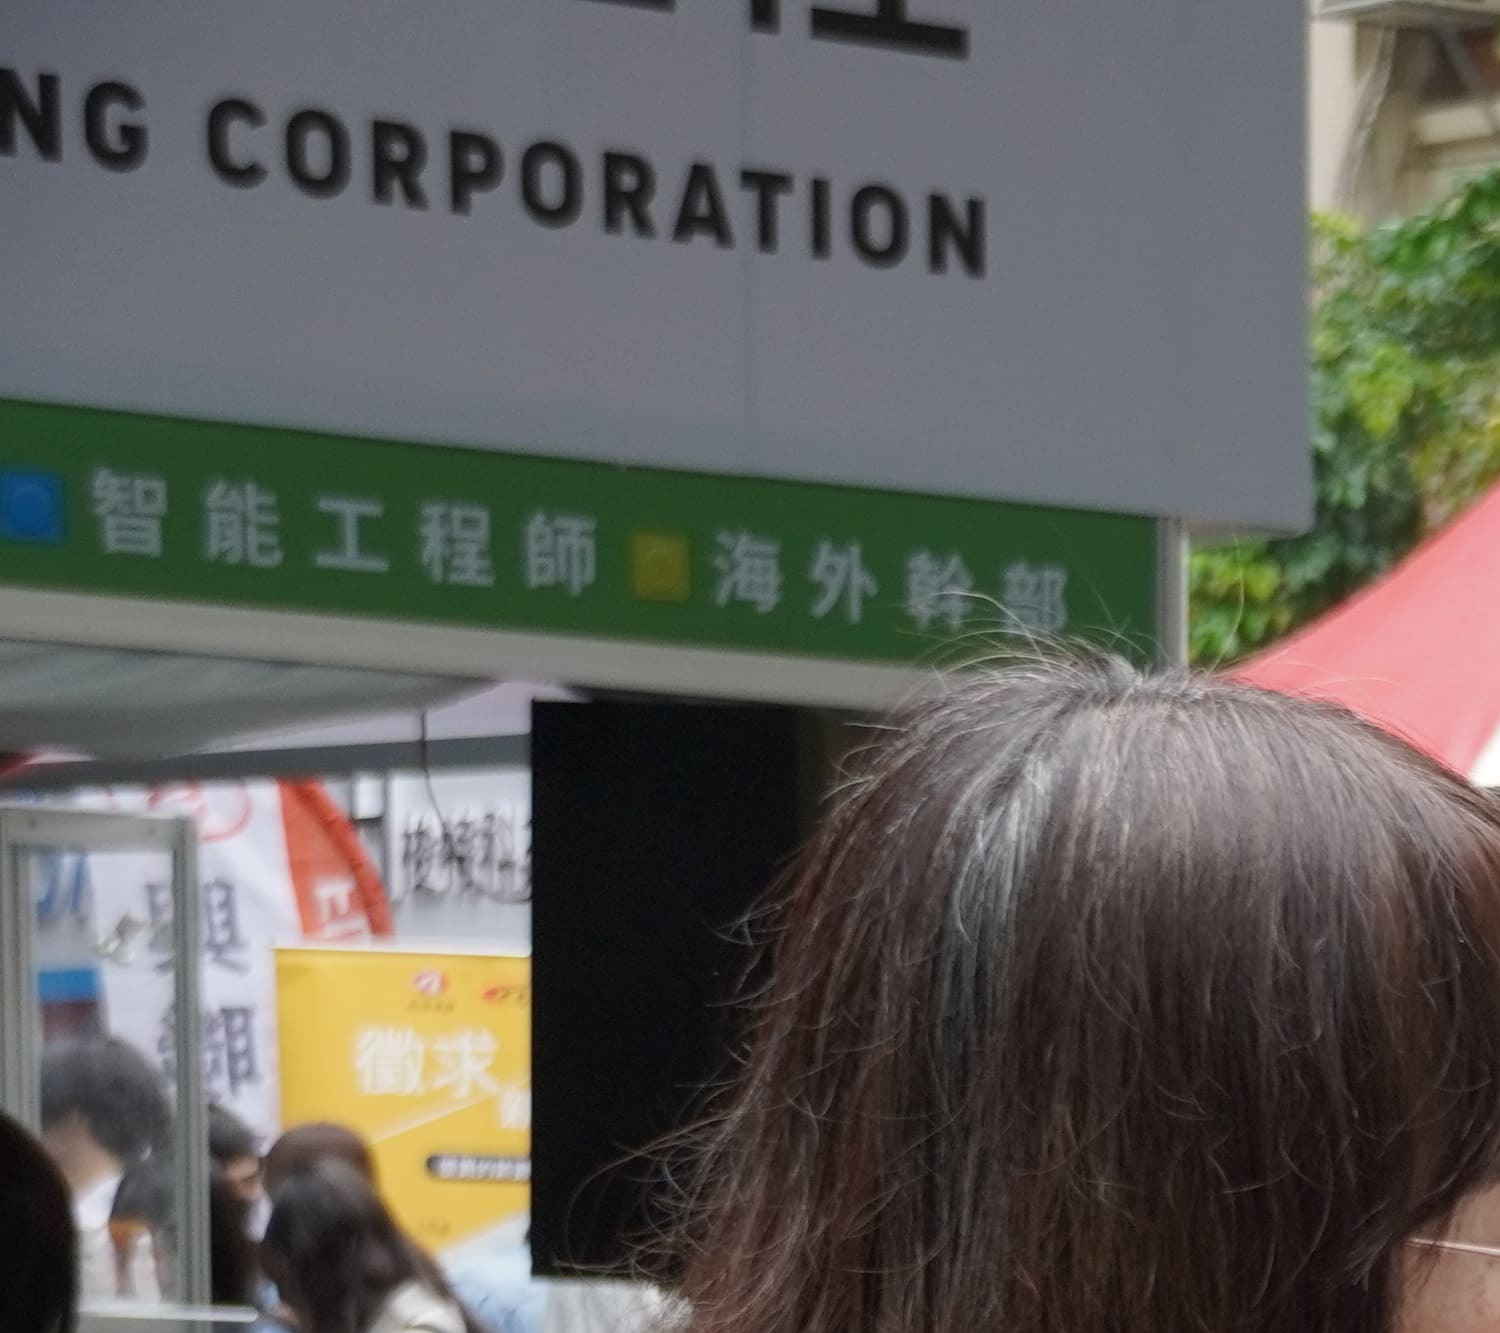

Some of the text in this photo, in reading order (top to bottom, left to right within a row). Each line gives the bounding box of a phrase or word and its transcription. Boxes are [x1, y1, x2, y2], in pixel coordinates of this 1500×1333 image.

[205, 96, 990, 281] CORPORATION
[89, 466, 599, 597] 智能工程師
[711, 529, 1070, 637] 海外幹部
